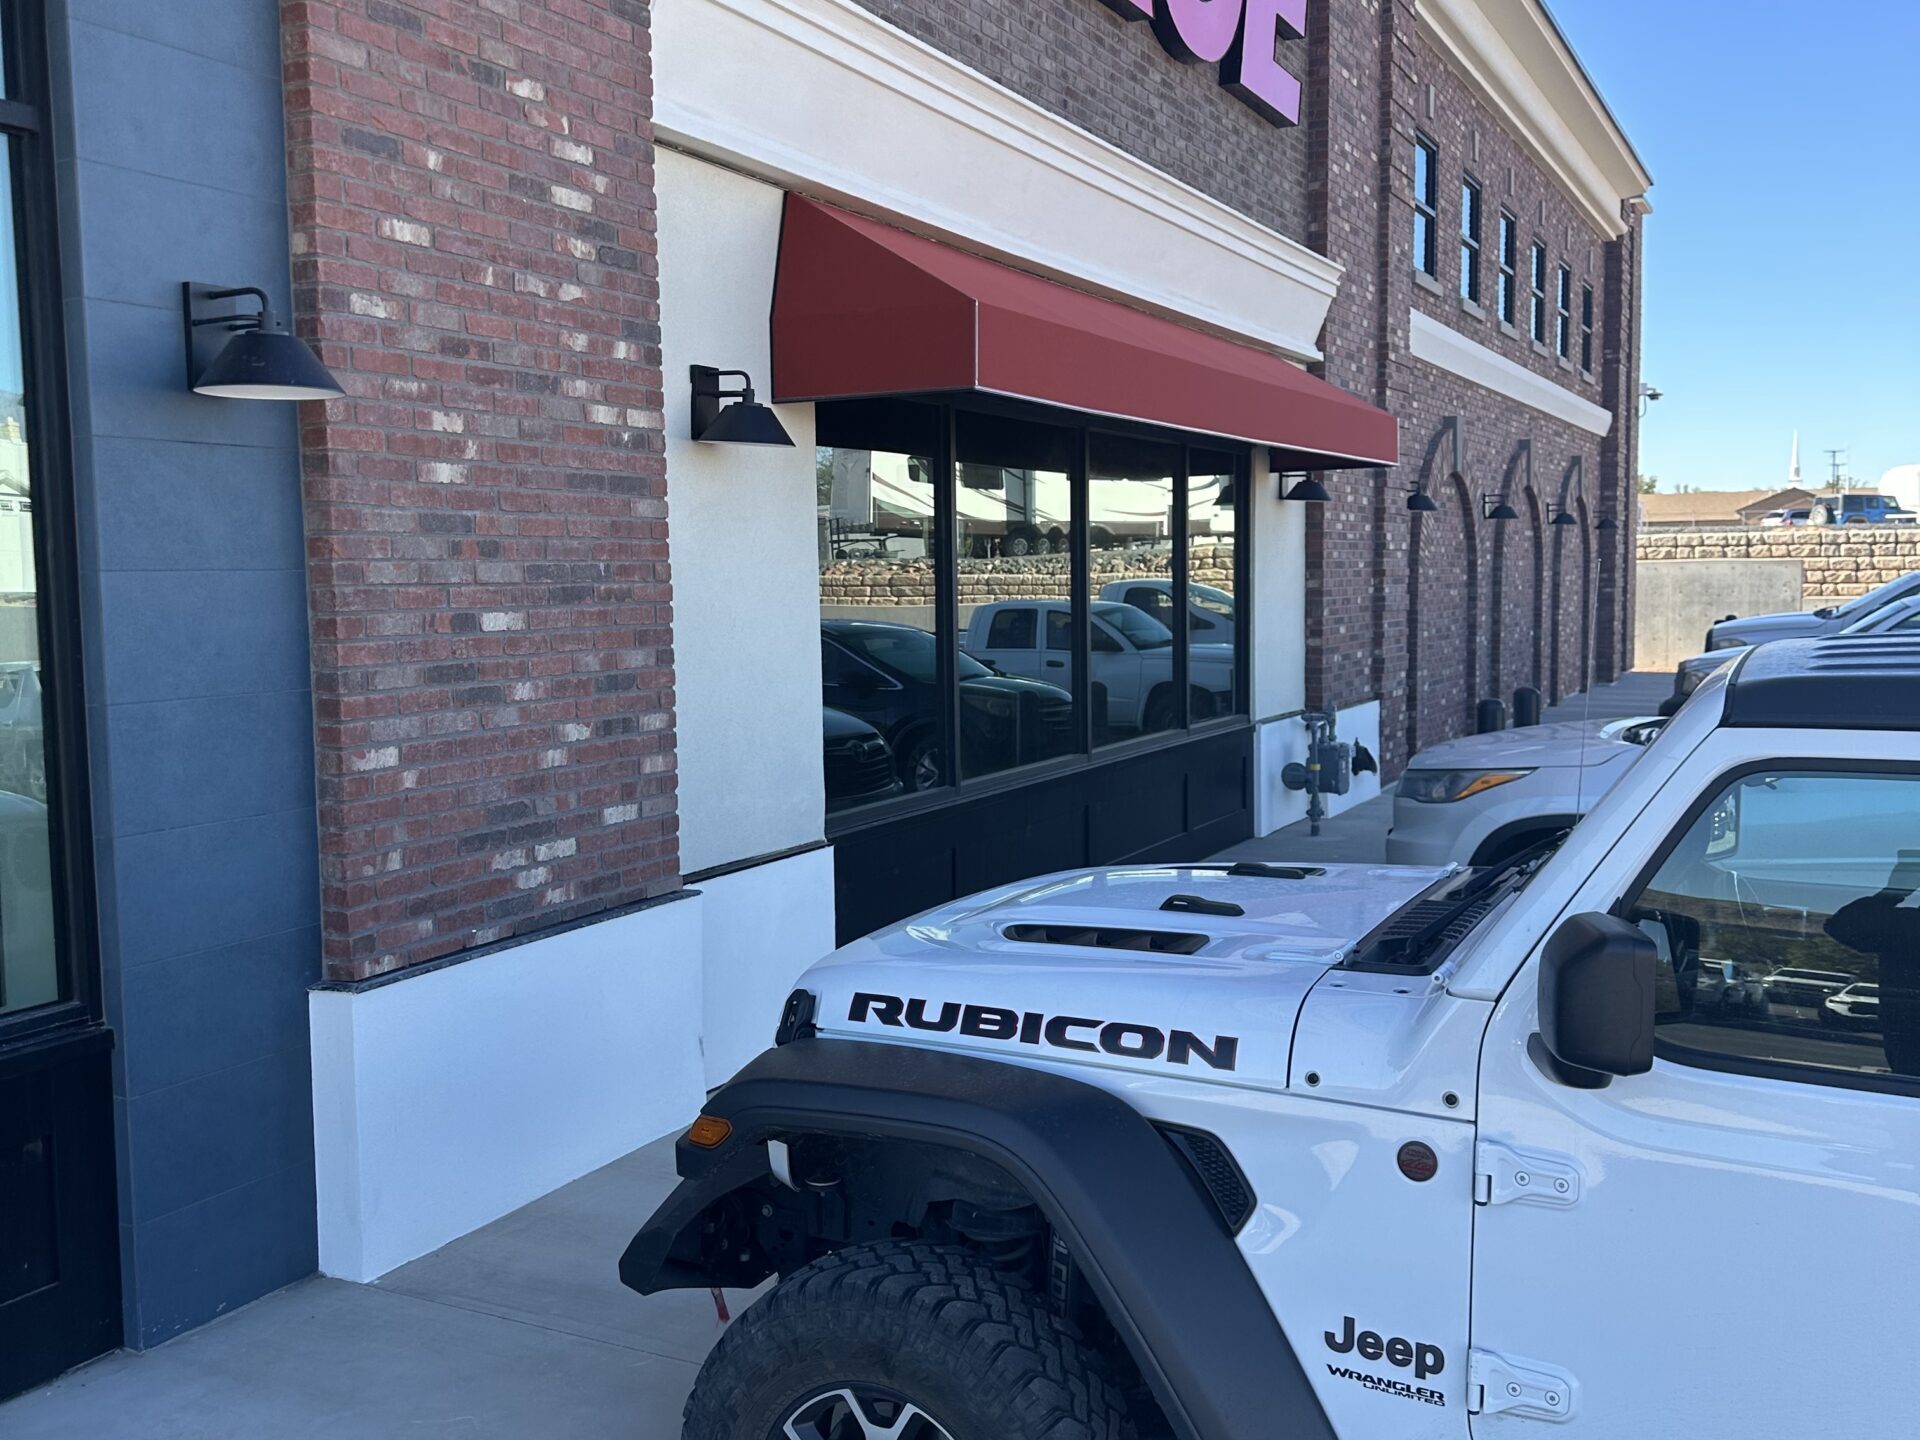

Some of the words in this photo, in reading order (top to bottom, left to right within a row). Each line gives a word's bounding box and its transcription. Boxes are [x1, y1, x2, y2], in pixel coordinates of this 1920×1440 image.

[848, 992, 1239, 1071] RUBICON
[1324, 1316, 1445, 1380] Jeep
[1326, 1364, 1444, 1401] WRANGLER
[1363, 1383, 1445, 1407] UNLIMITED
